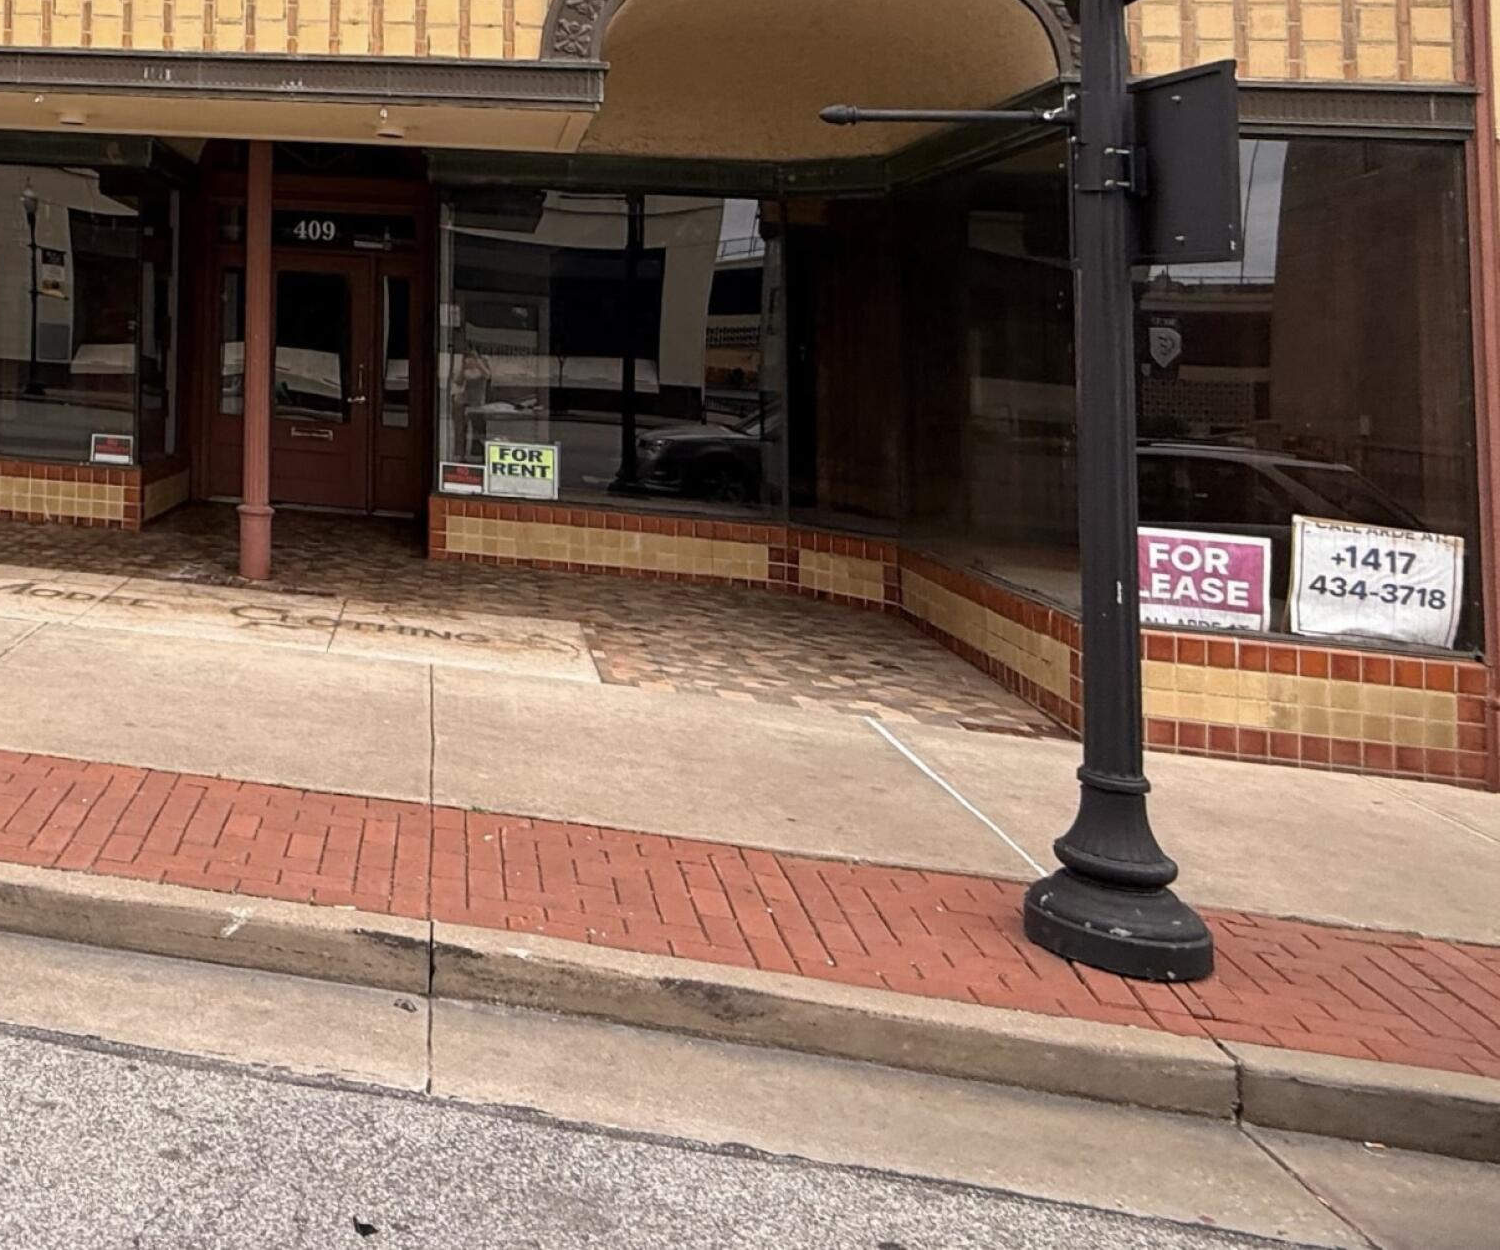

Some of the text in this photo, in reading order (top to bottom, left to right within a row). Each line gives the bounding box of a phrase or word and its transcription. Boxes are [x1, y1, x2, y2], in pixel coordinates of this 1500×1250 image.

[293, 220, 336, 241] 409
[499, 448, 543, 463] FOR
[492, 462, 551, 478] RENT
[1148, 542, 1229, 575] FOR
[1330, 545, 1416, 574] +1417
[1308, 574, 1446, 610] 434-3718
